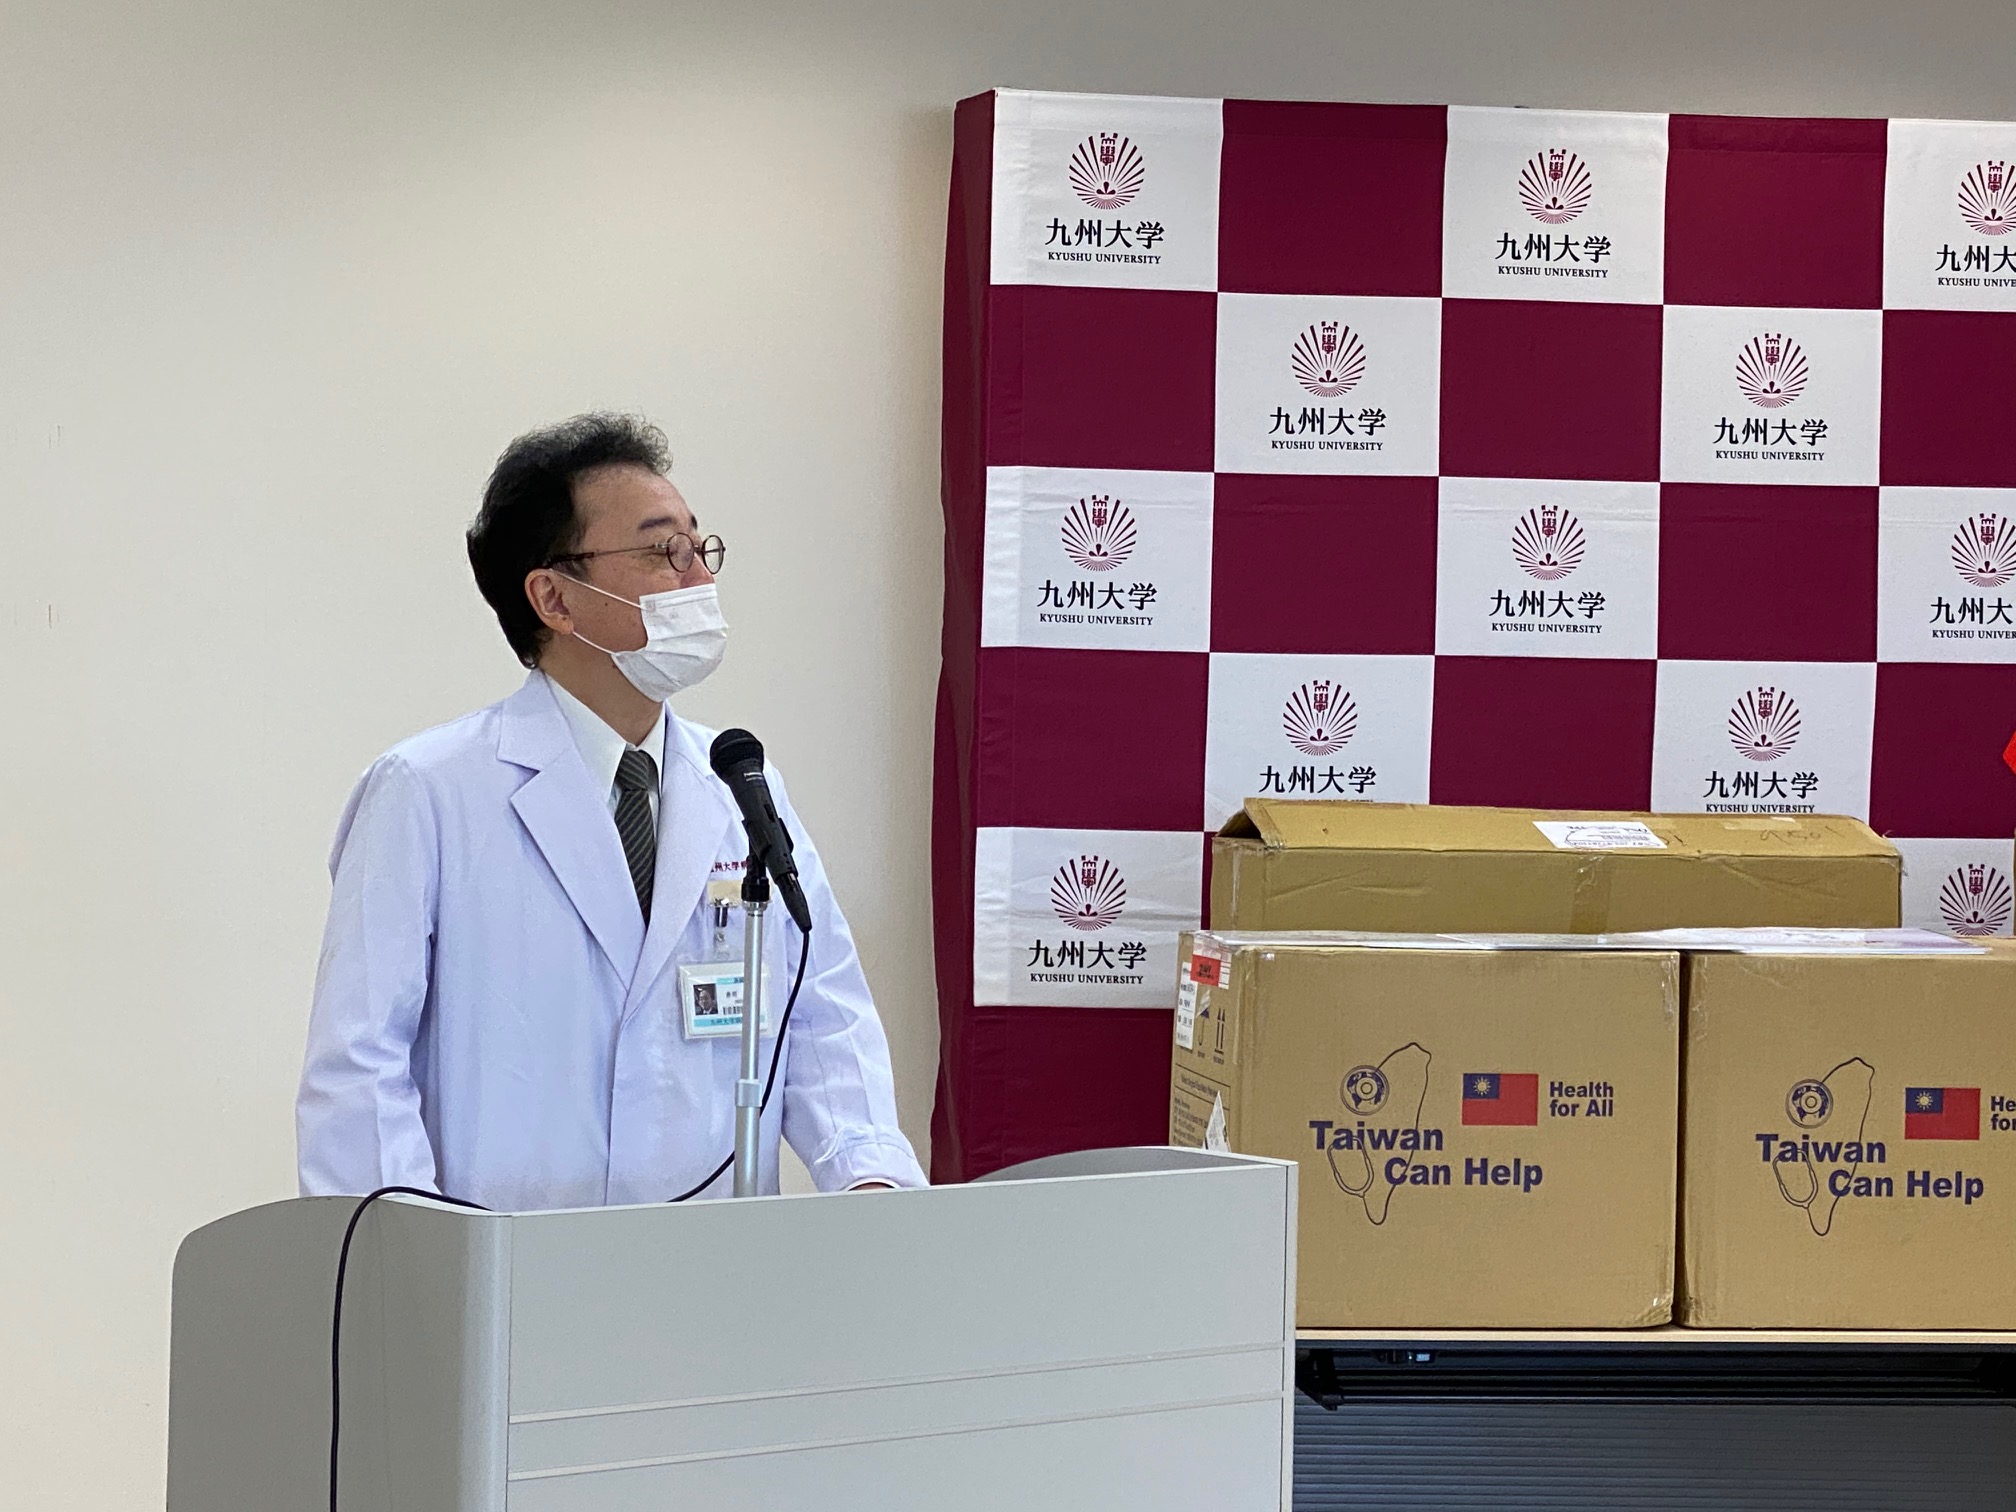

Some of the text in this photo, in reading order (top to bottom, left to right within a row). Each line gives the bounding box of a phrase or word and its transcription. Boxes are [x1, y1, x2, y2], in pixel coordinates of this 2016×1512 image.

[1045, 217, 1165, 249] 九州大学
[1048, 251, 1161, 264] KYUSHU UNIVERSITY
[1494, 232, 1612, 264] 九州大学
[1935, 243, 2016, 273] 九州大
[1498, 265, 1609, 278] KYUSHU UNIVERSITY
[1937, 277, 1980, 287] KYUSHU
[1268, 406, 1387, 436] 九州大学
[1713, 416, 1829, 447] 九州大学
[1271, 440, 1383, 451] KYUSHU UNIVERSITY
[1715, 450, 1825, 461] KYUSHU UNIVERSITY
[1037, 579, 1158, 611] 九州大学
[1488, 589, 1606, 619] 九州大学
[1039, 613, 1153, 626] KYUSHU UNIVERSITY
[1492, 622, 1603, 634] KYUSHU UNIVERSITY
[1932, 629, 1975, 638] KYUSHU
[1258, 765, 1377, 794] 九州大学
[1702, 770, 1819, 800] 九州大学
[1706, 803, 1815, 813] KYUSHU UNIVERSITY
[1026, 939, 1147, 970] 九州大学
[1030, 973, 1144, 985] KYUSHU UNIVERSITY
[1549, 1081, 1614, 1099] Health
[1549, 1099, 1614, 1117] for All
[1309, 1120, 1444, 1151] Taiwan
[1755, 1133, 1886, 1164] Taiwan
[1384, 1157, 1544, 1193] Can Help
[1828, 1169, 1984, 1205] Can Help
